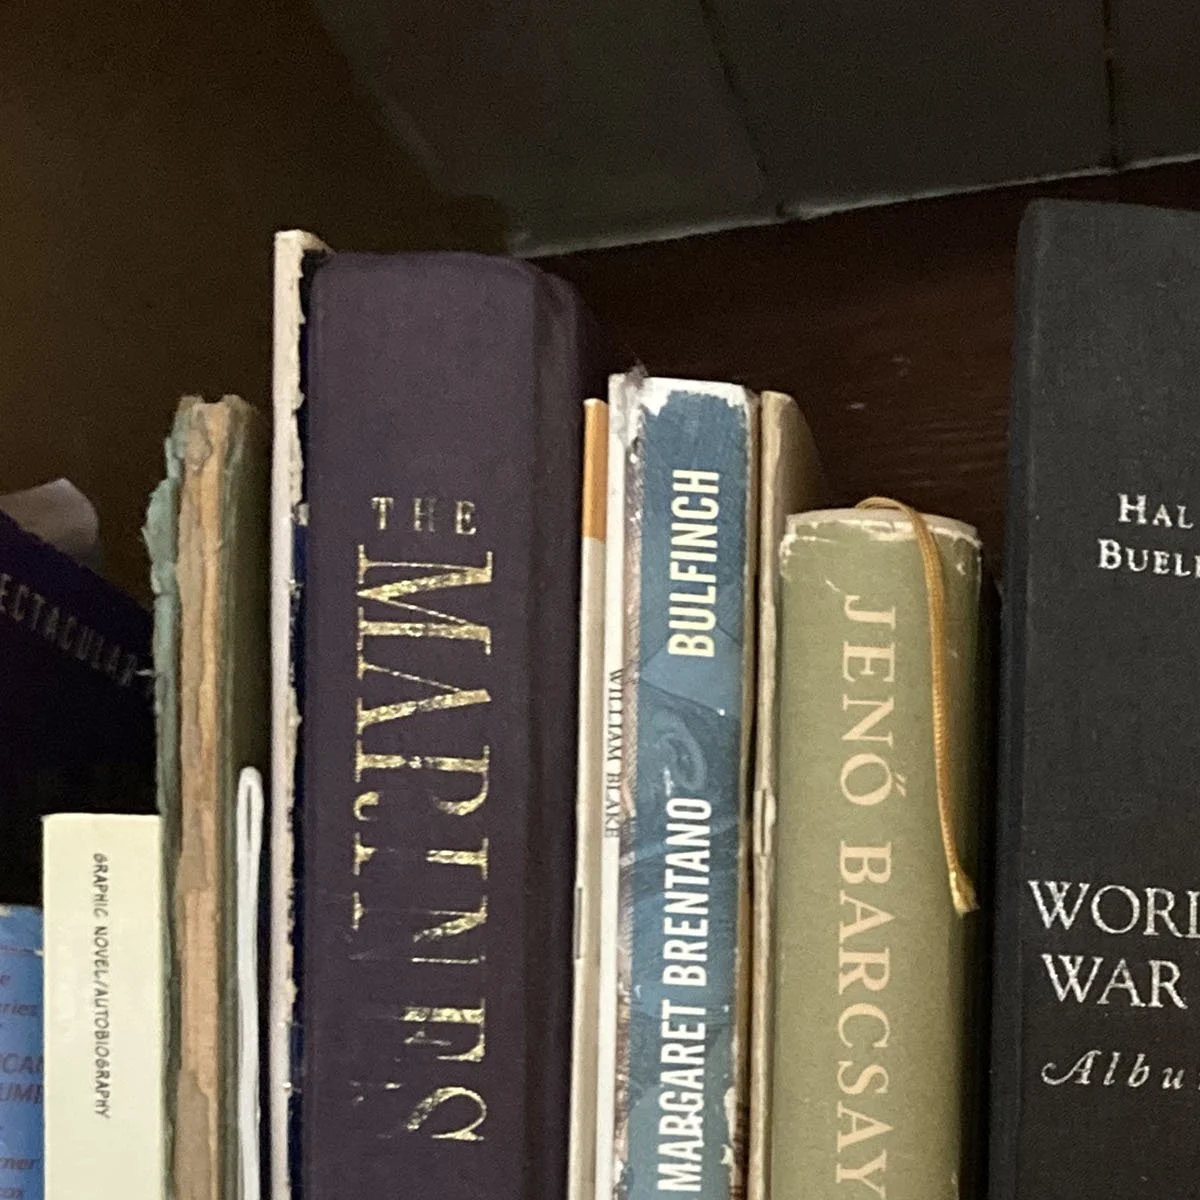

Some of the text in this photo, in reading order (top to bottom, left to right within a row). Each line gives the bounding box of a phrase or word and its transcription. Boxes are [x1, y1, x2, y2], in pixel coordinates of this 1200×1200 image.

[371, 496, 477, 535] THE
[668, 470, 720, 658] BULFINCH
[604, 667, 624, 839] WILLIAM BLAKE
[93, 852, 109, 918] GRAPHIC
[661, 796, 712, 987] BRENTANO
[836, 841, 896, 1200] BARCSAY
[1041, 953, 1189, 1009] WAR
[656, 999, 707, 1192] MARGARET
